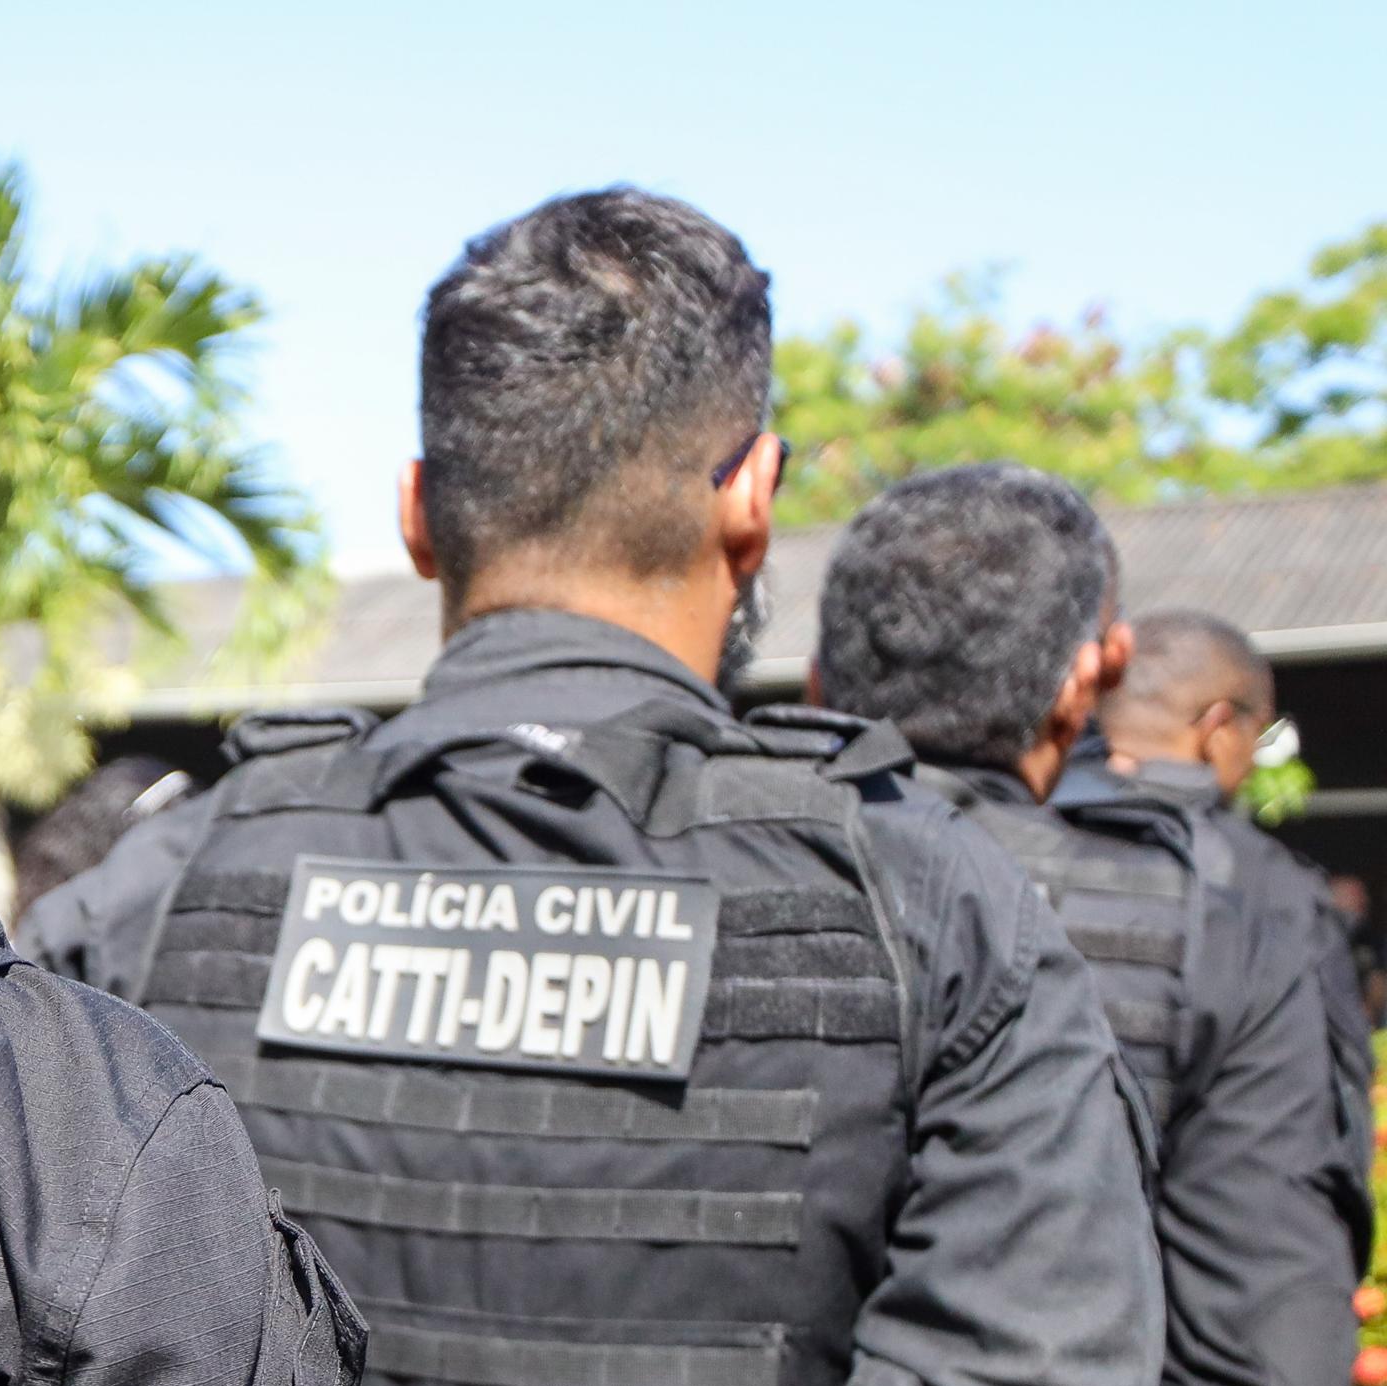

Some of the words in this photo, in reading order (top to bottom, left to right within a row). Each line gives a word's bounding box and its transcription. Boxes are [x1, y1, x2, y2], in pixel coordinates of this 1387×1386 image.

[303, 872, 519, 932] POLÍCIA
[534, 886, 693, 940] CIVIL
[283, 938, 687, 1065] CATTI-DEPIN
